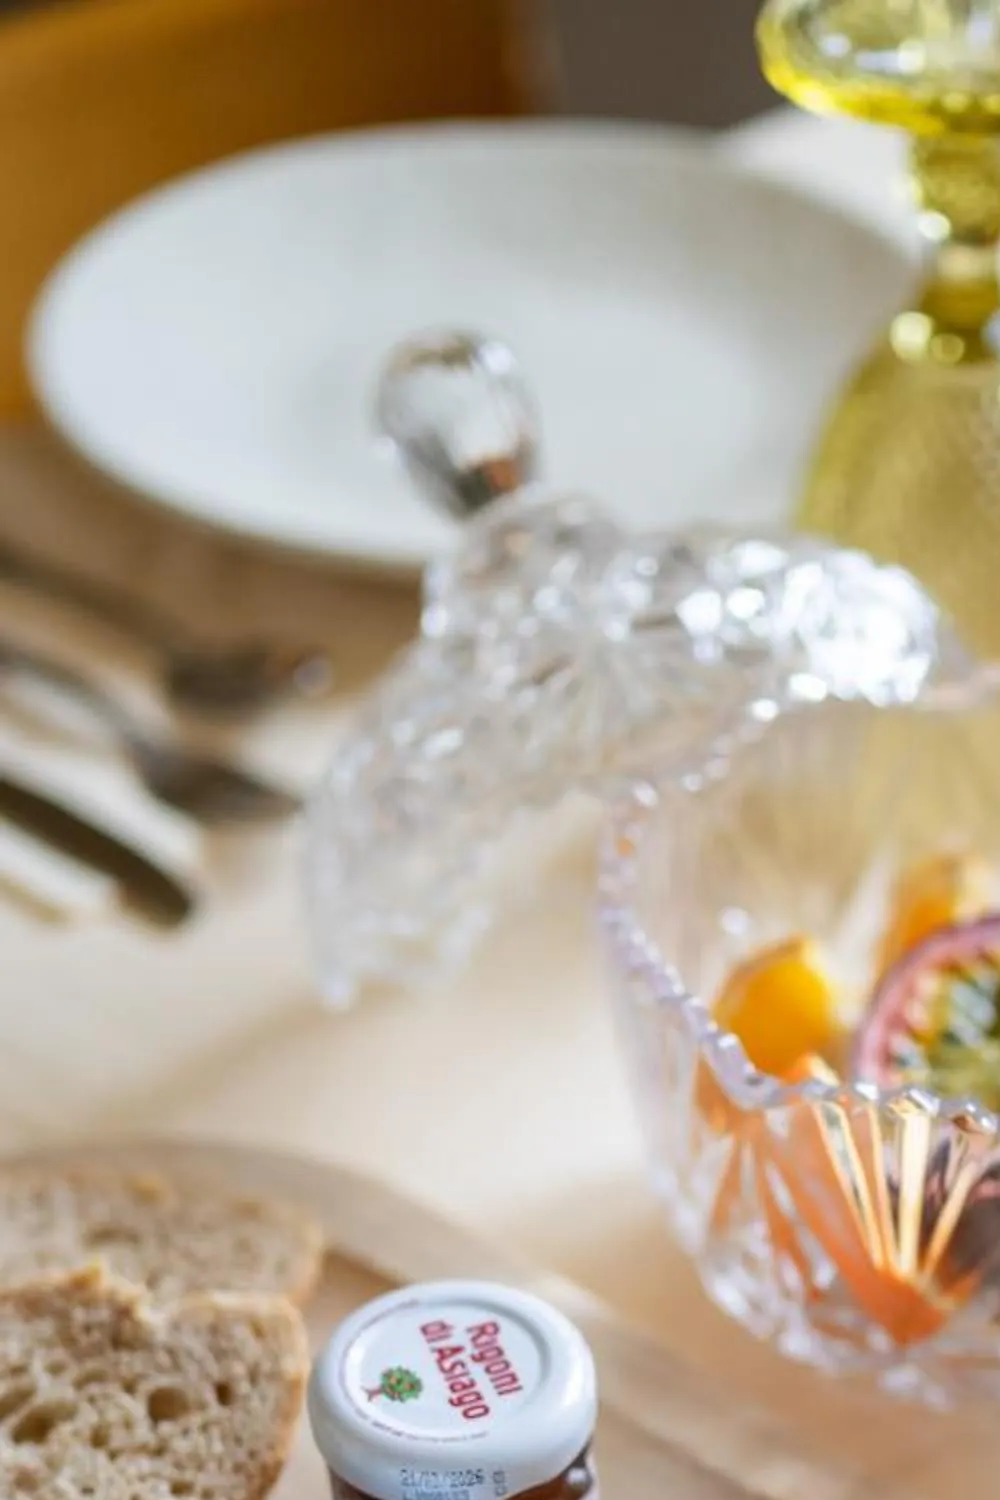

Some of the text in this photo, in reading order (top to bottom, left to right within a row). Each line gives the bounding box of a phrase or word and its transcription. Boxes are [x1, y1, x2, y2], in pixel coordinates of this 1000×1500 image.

[420, 1319, 490, 1420] di Asiago
[465, 1321, 524, 1396] Rigoni
